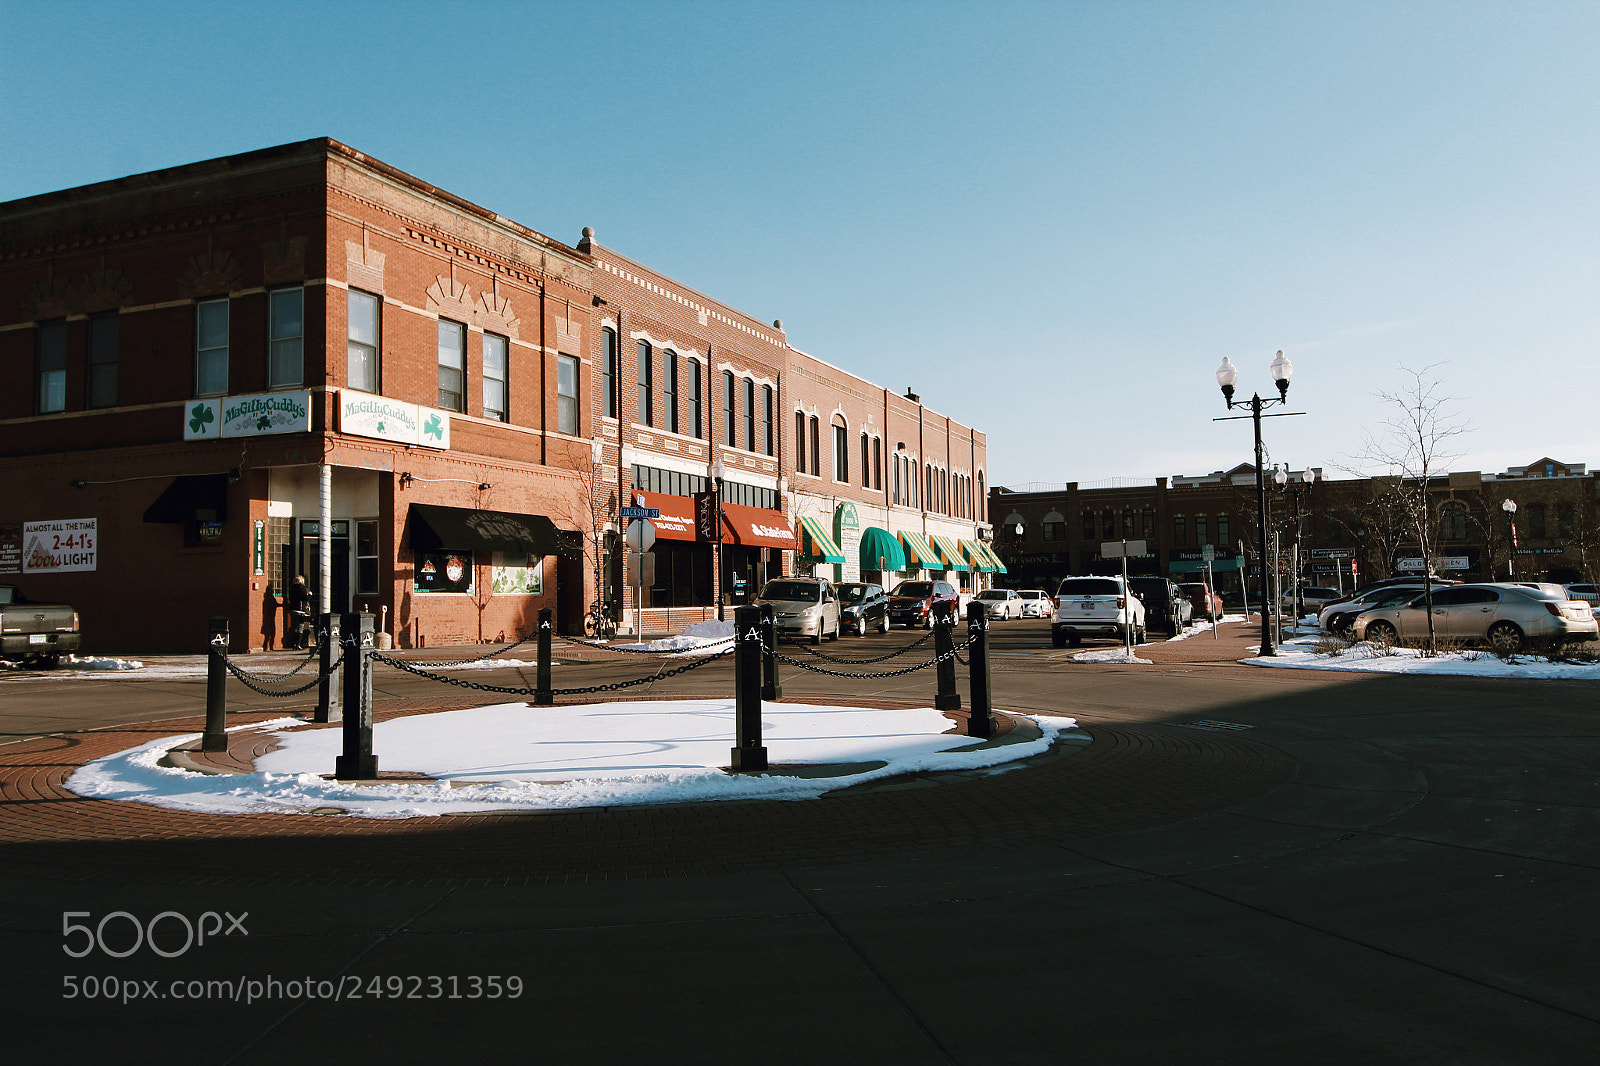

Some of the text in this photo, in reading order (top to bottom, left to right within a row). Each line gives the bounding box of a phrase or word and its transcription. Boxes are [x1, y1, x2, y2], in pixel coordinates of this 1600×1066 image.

[621, 508, 659, 518] JACKSON ST
[701, 495, 711, 538] ANOKA
[25, 521, 96, 533] ALMOST ALL THE TIME
[52, 533, 93, 551] 2-4-1's
[27, 549, 95, 568] Coors LIGHT
[541, 620, 551, 629] A
[941, 614, 951, 624] A
[969, 618, 982, 631] A
[210, 633, 226, 645] A
[362, 632, 374, 647] A
[744, 626, 760, 641] A
